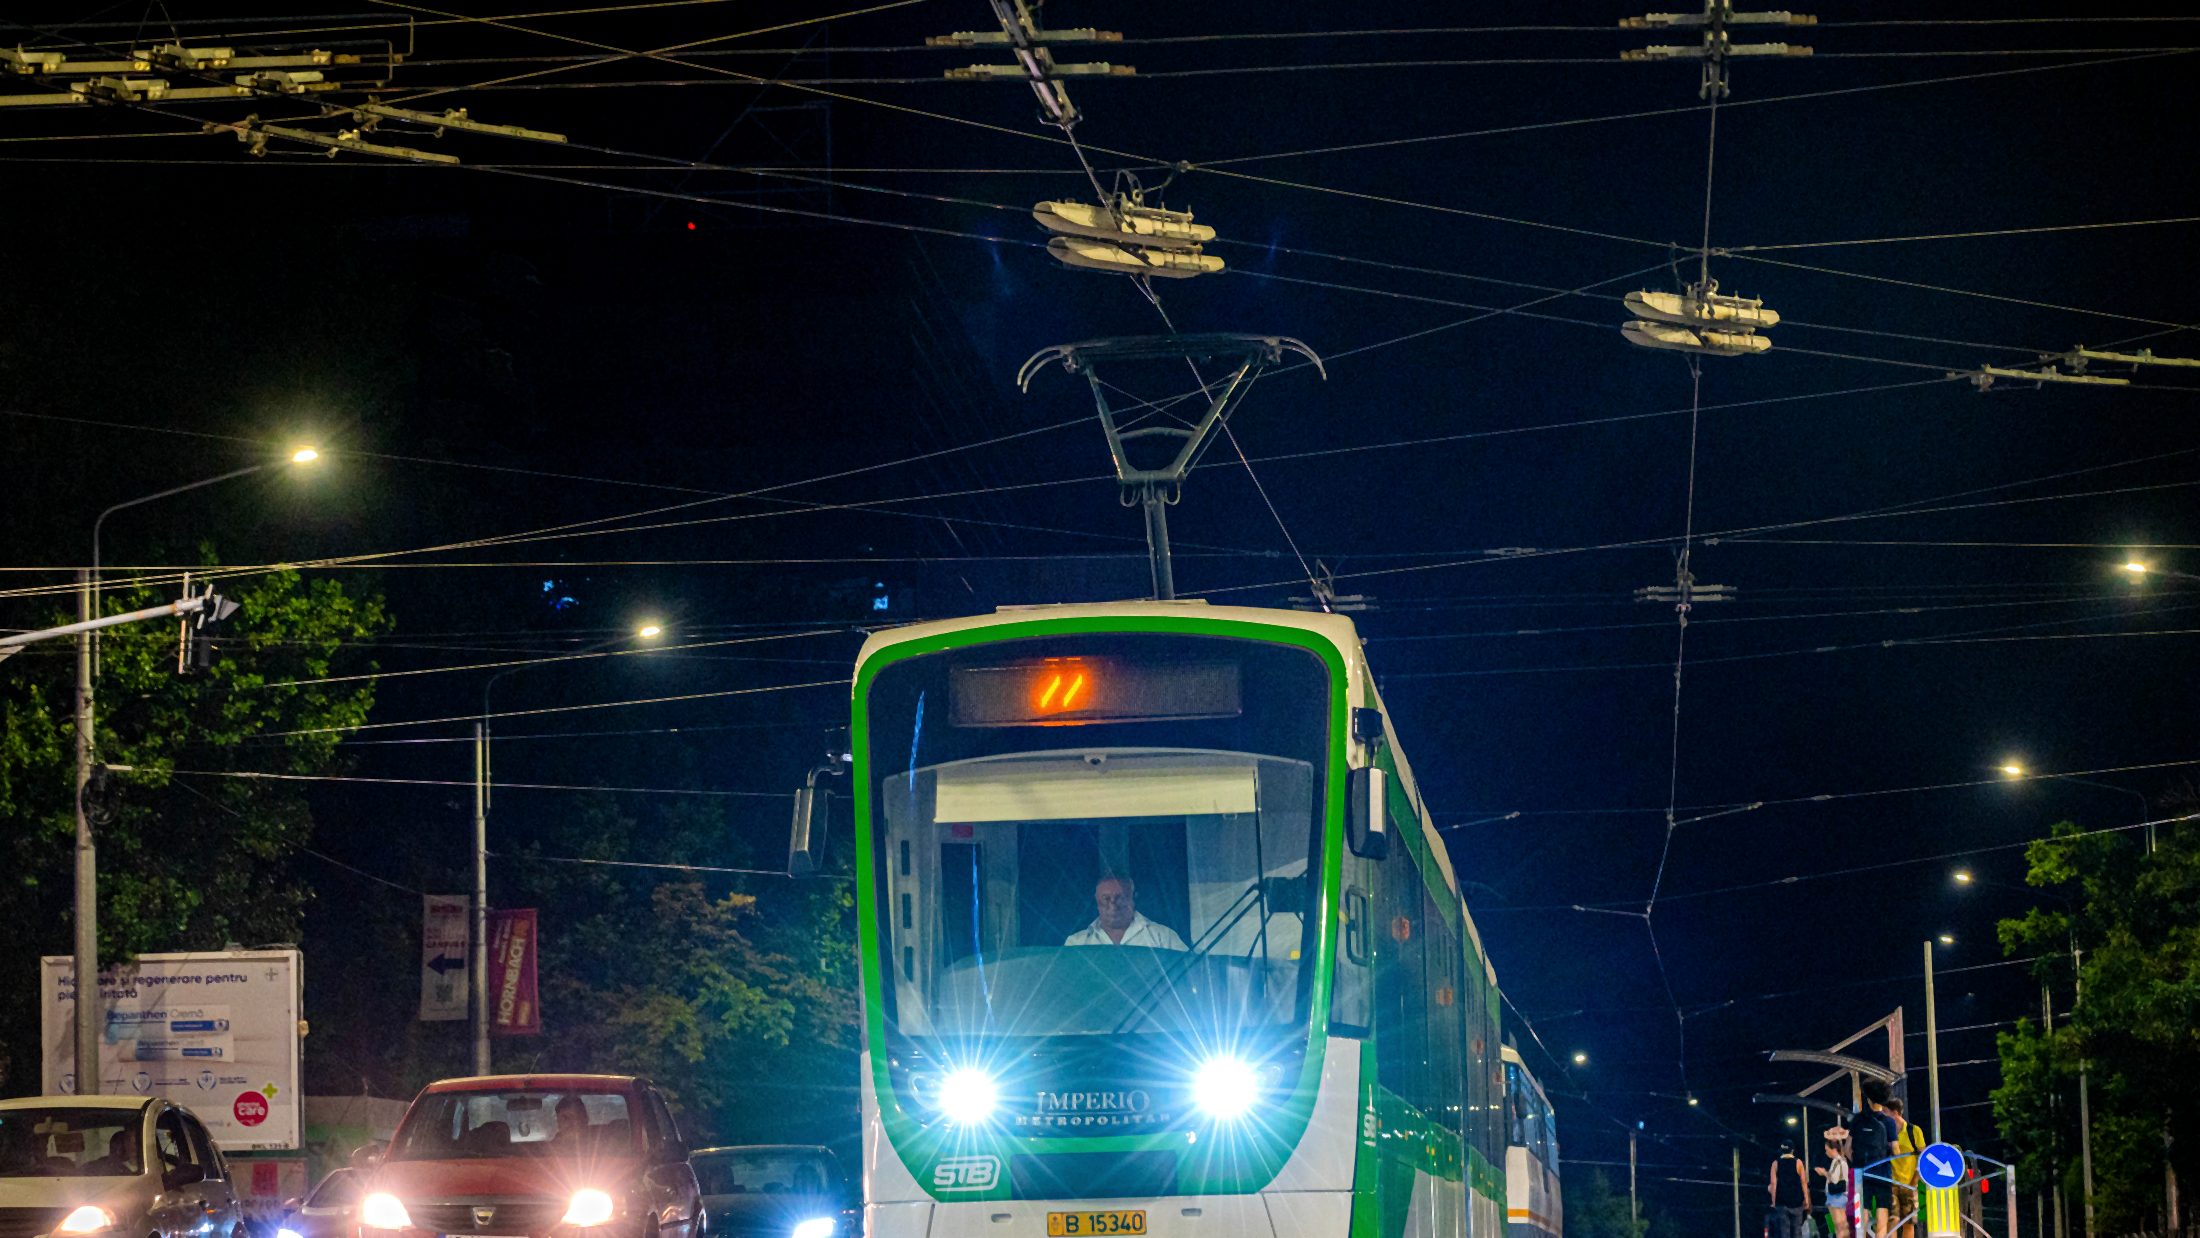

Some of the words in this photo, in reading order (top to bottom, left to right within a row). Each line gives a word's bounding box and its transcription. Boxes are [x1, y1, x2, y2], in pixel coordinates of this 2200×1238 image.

[133, 975, 202, 987] regenerare
[205, 973, 248, 986] pentru
[498, 938, 526, 1026] HORNBACH
[1035, 1089, 1151, 1115] IMPERIO
[1015, 1112, 1171, 1126] METROPOLITAN
[933, 1161, 994, 1186] STB
[1065, 1214, 1079, 1233] B
[1088, 1213, 1143, 1233] 15340
